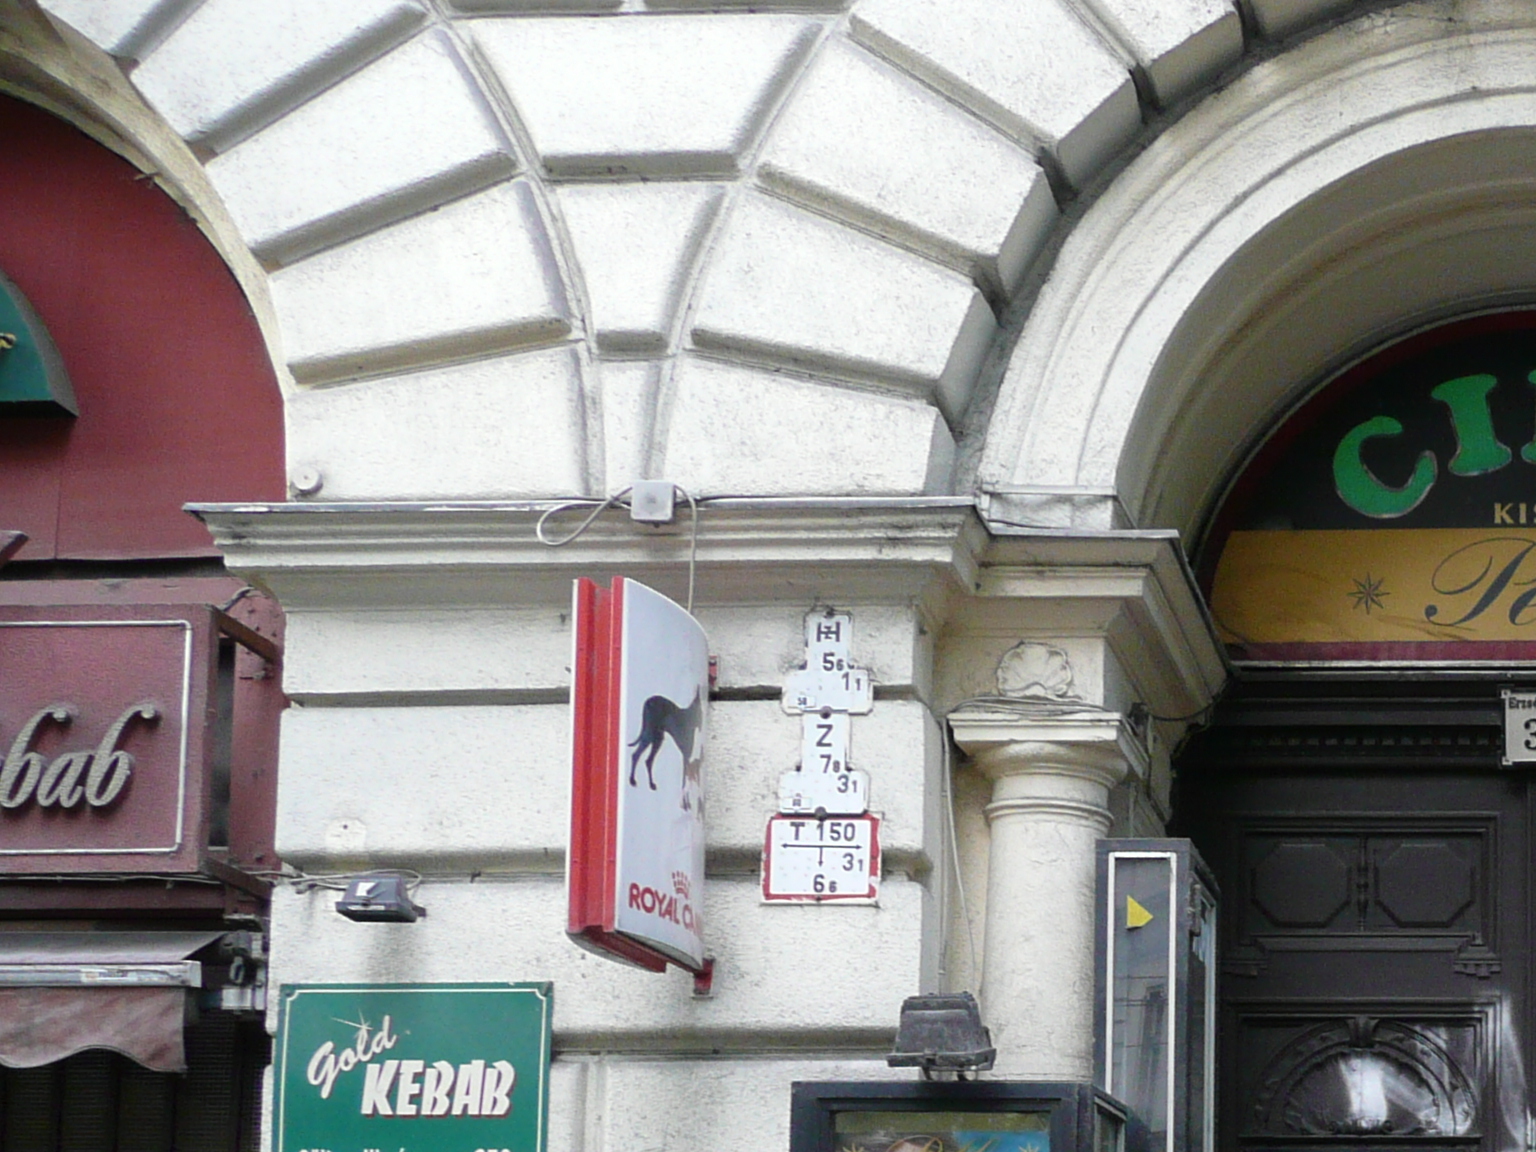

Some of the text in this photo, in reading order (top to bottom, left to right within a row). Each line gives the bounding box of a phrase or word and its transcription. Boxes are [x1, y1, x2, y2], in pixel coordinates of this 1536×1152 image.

[815, 723, 833, 747] Z
[790, 822, 856, 841] T 150
[628, 882, 681, 925] ROYAL
[306, 1014, 398, 1099] Gold
[361, 1059, 517, 1118] KEBAB
